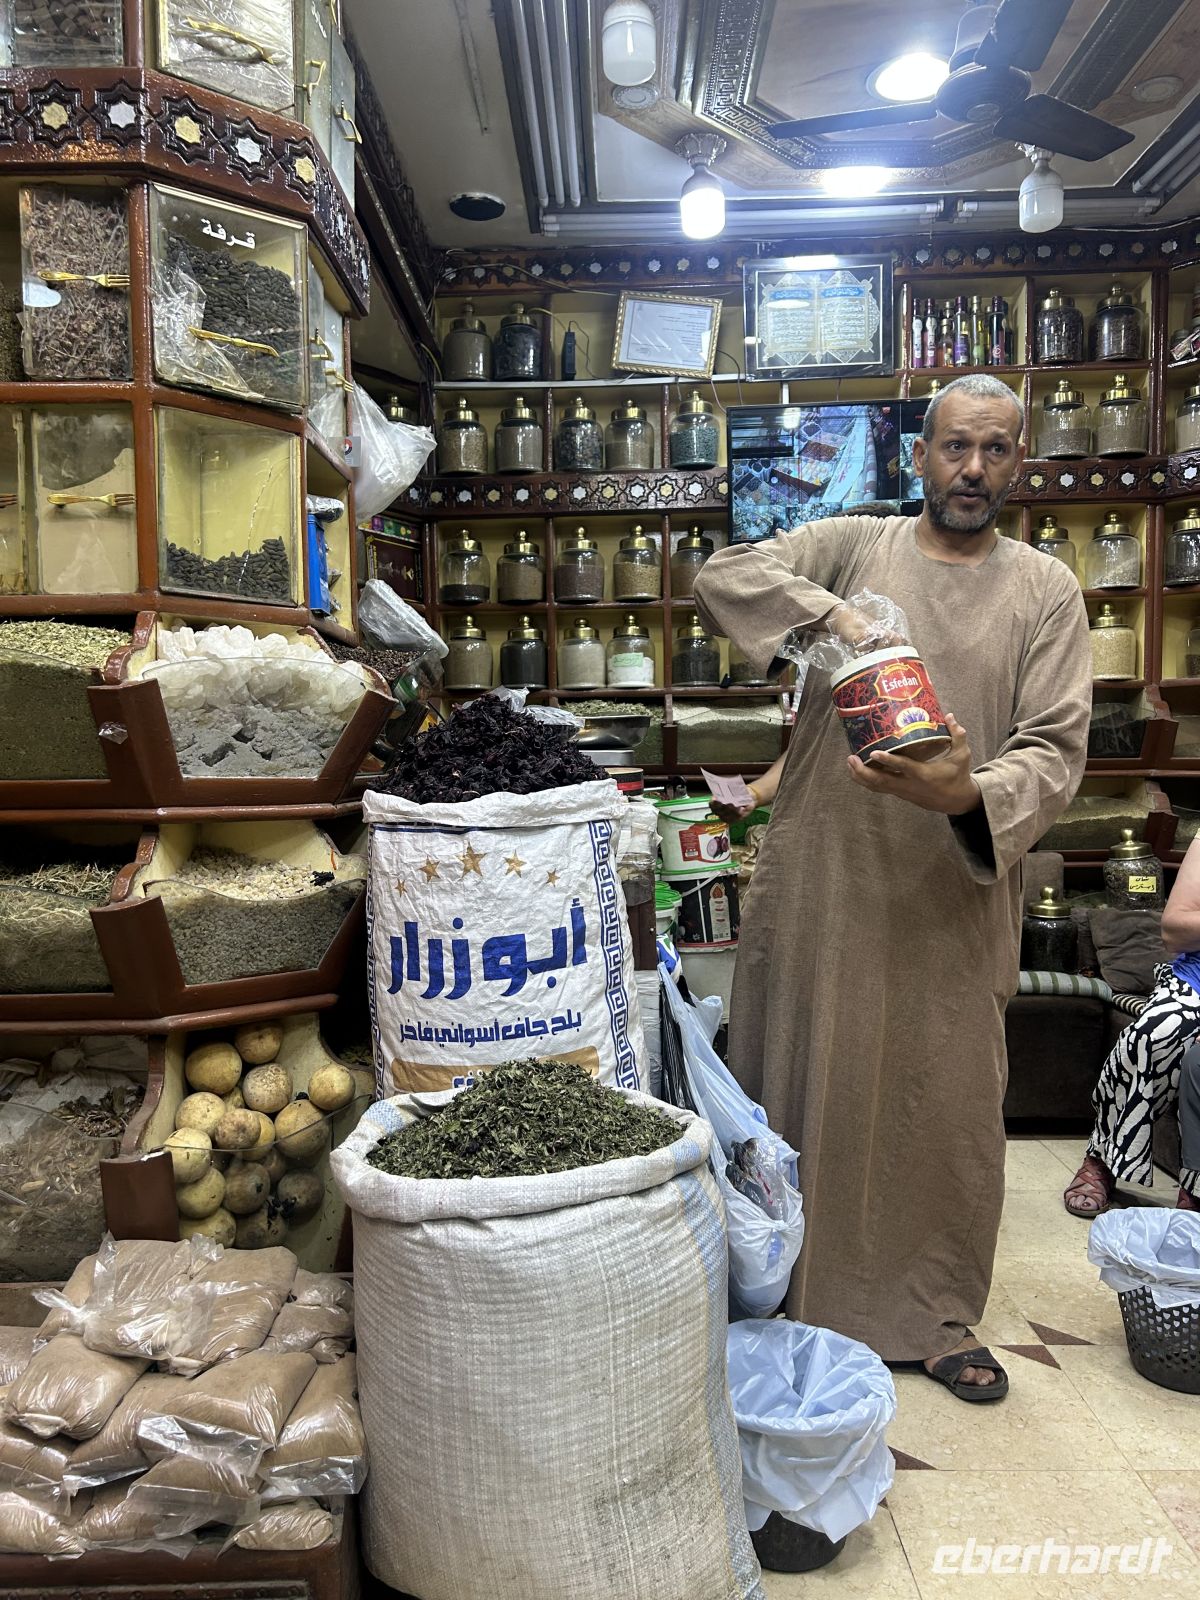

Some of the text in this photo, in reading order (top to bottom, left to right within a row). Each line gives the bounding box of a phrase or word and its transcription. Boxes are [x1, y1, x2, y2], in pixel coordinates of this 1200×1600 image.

[201, 218, 256, 249] قرفة
[882, 676, 918, 693] Esfedan
[387, 898, 588, 1000] أبو زرار
[400, 1008, 582, 1048] بلح جاف أسواني فاخر
